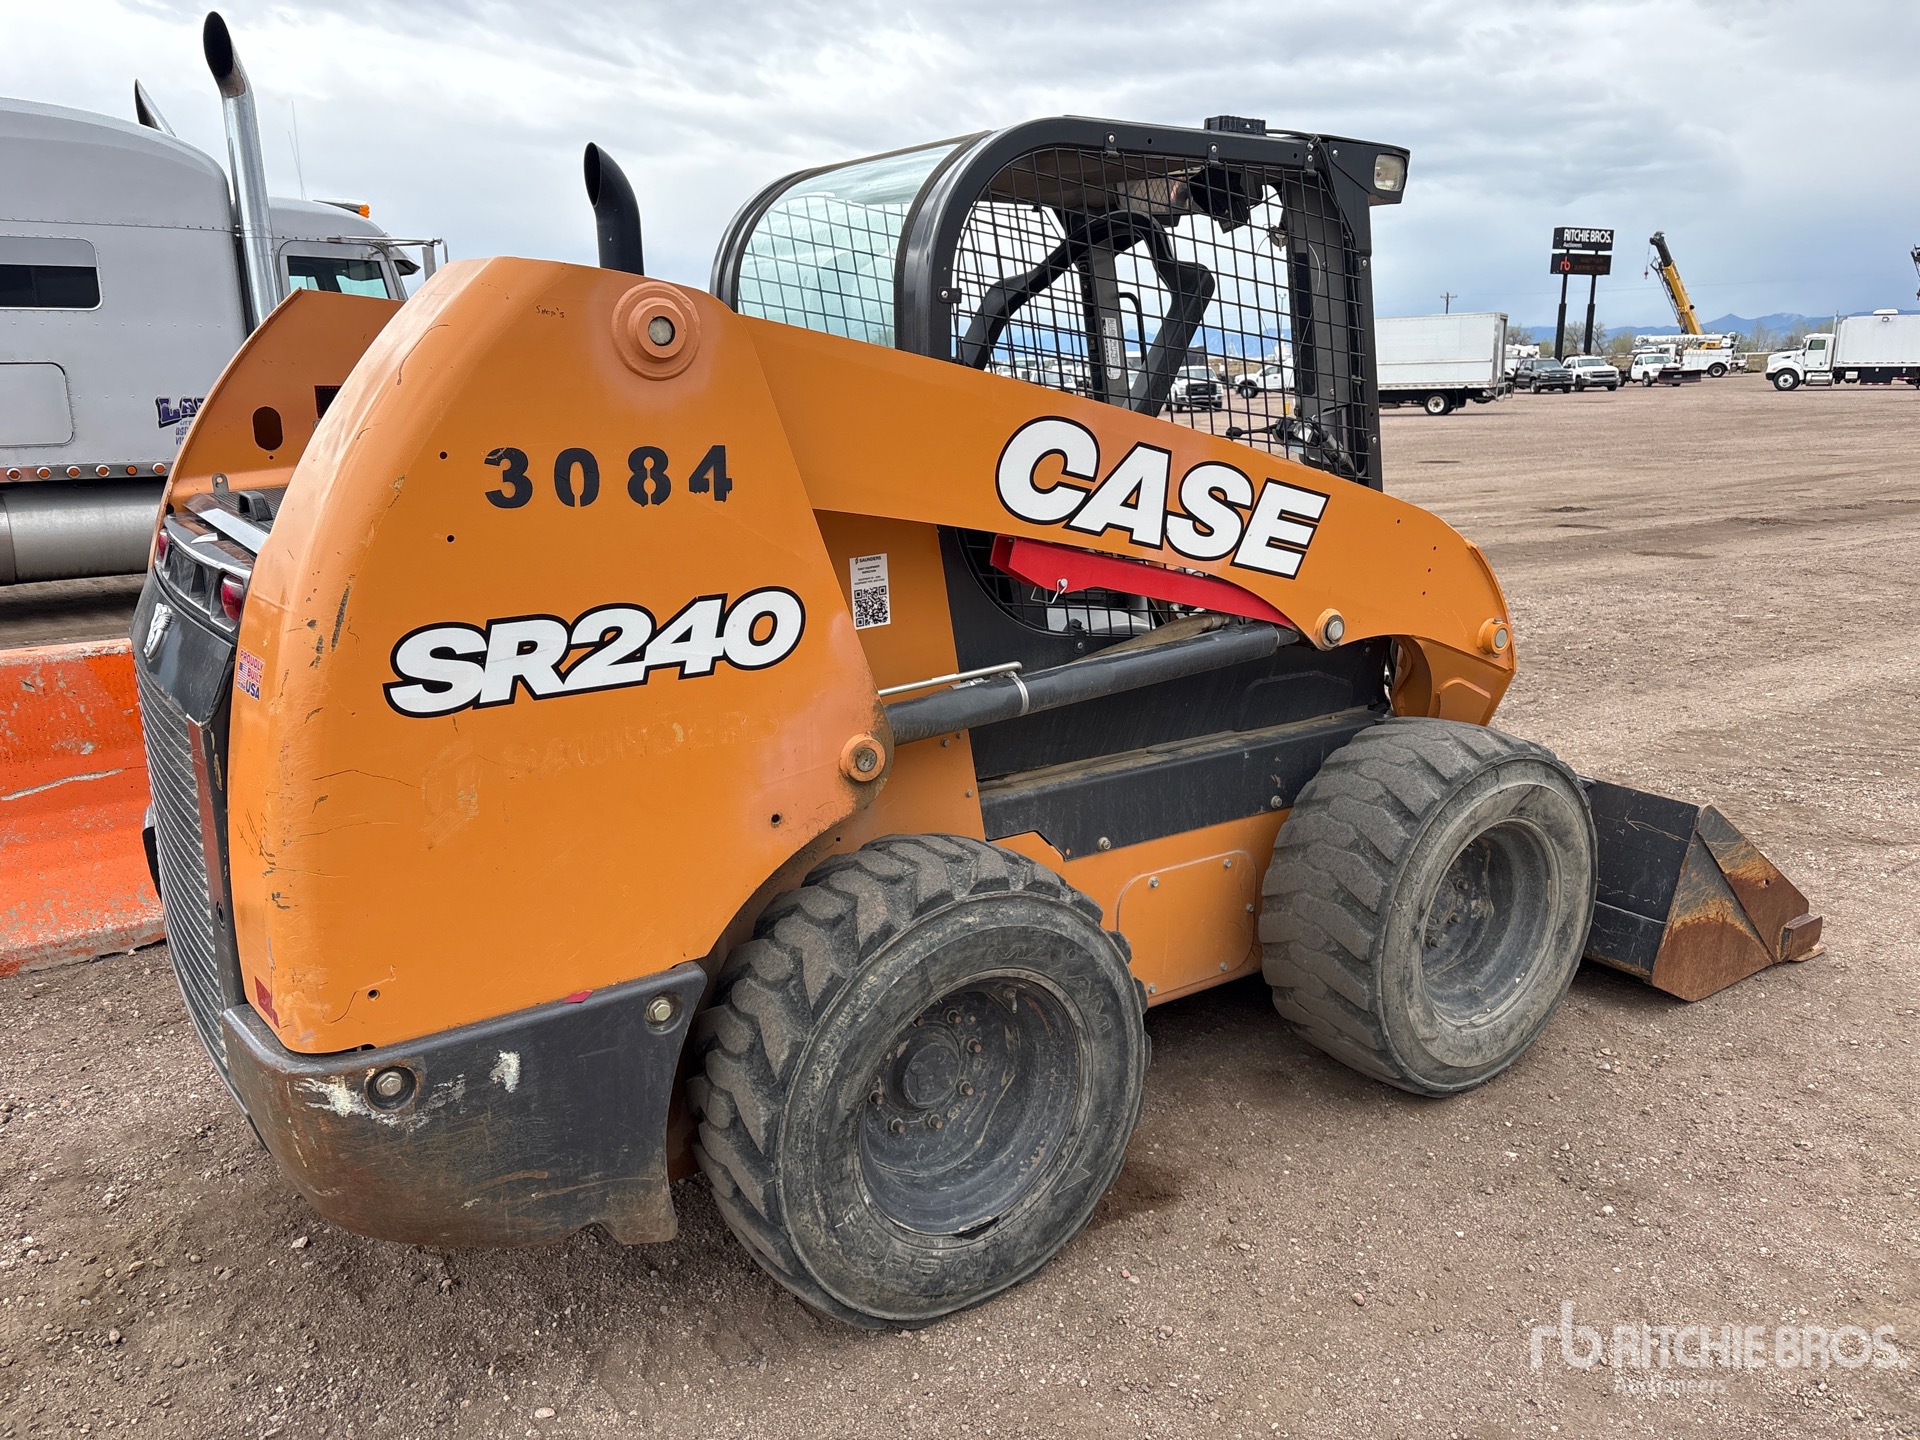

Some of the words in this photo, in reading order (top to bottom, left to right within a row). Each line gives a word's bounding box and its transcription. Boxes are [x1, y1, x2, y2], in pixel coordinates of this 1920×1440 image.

[1563, 229, 1590, 242] RITCHIE
[1590, 230, 1612, 243] BROS.
[1560, 255, 1571, 270] rb
[484, 445, 733, 508] 3084
[995, 416, 1331, 580] CASE
[240, 650, 263, 671] PROUDLY
[382, 586, 806, 718] SR240
[247, 667, 262, 684] BUILT
[245, 680, 260, 700] USA
